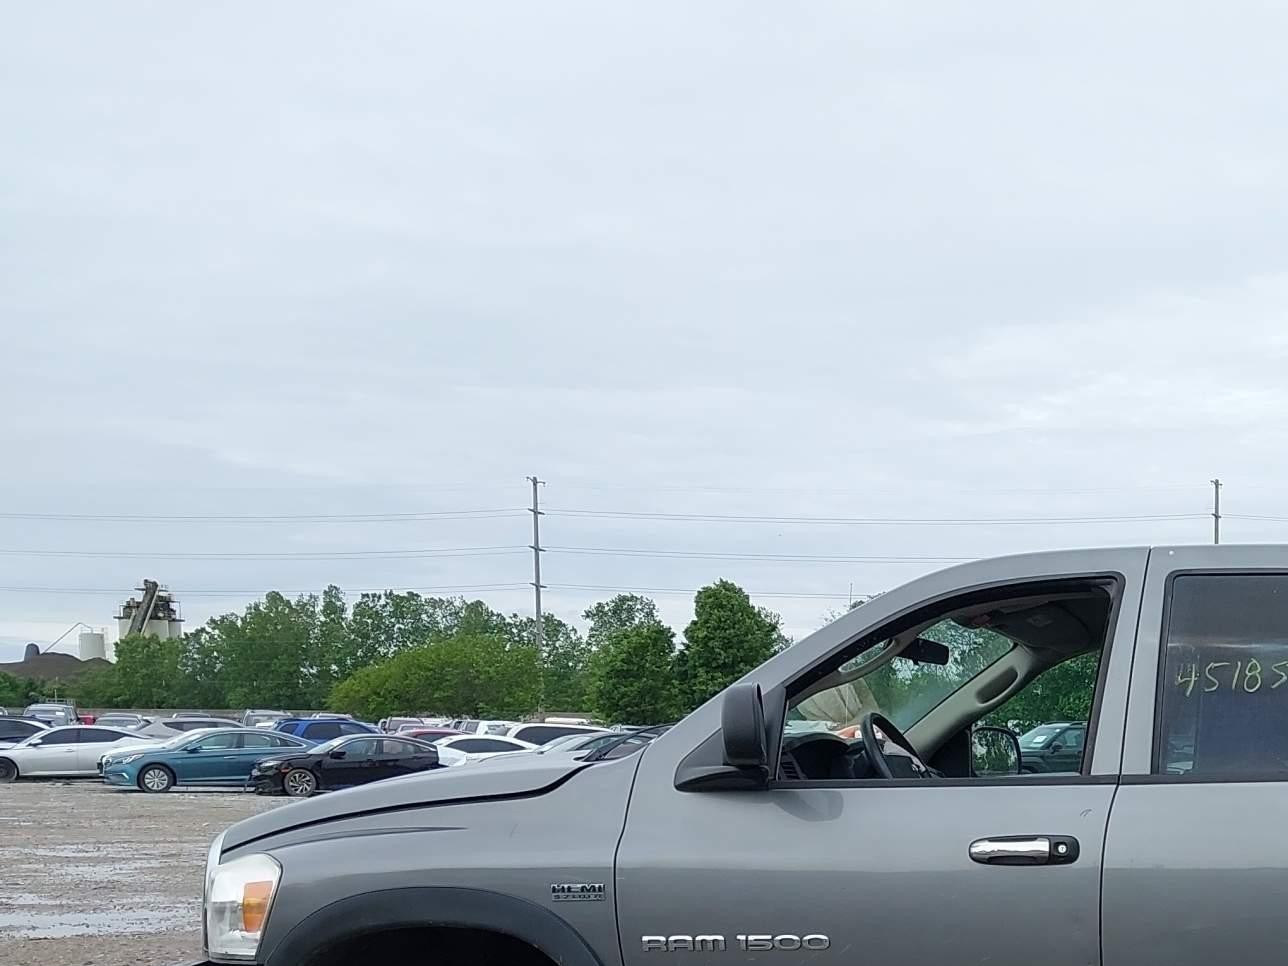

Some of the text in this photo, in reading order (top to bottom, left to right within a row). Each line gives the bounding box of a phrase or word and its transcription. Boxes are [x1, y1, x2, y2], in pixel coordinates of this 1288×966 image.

[551, 883, 605, 893] HEMI
[641, 934, 830, 951] RAM 1500
